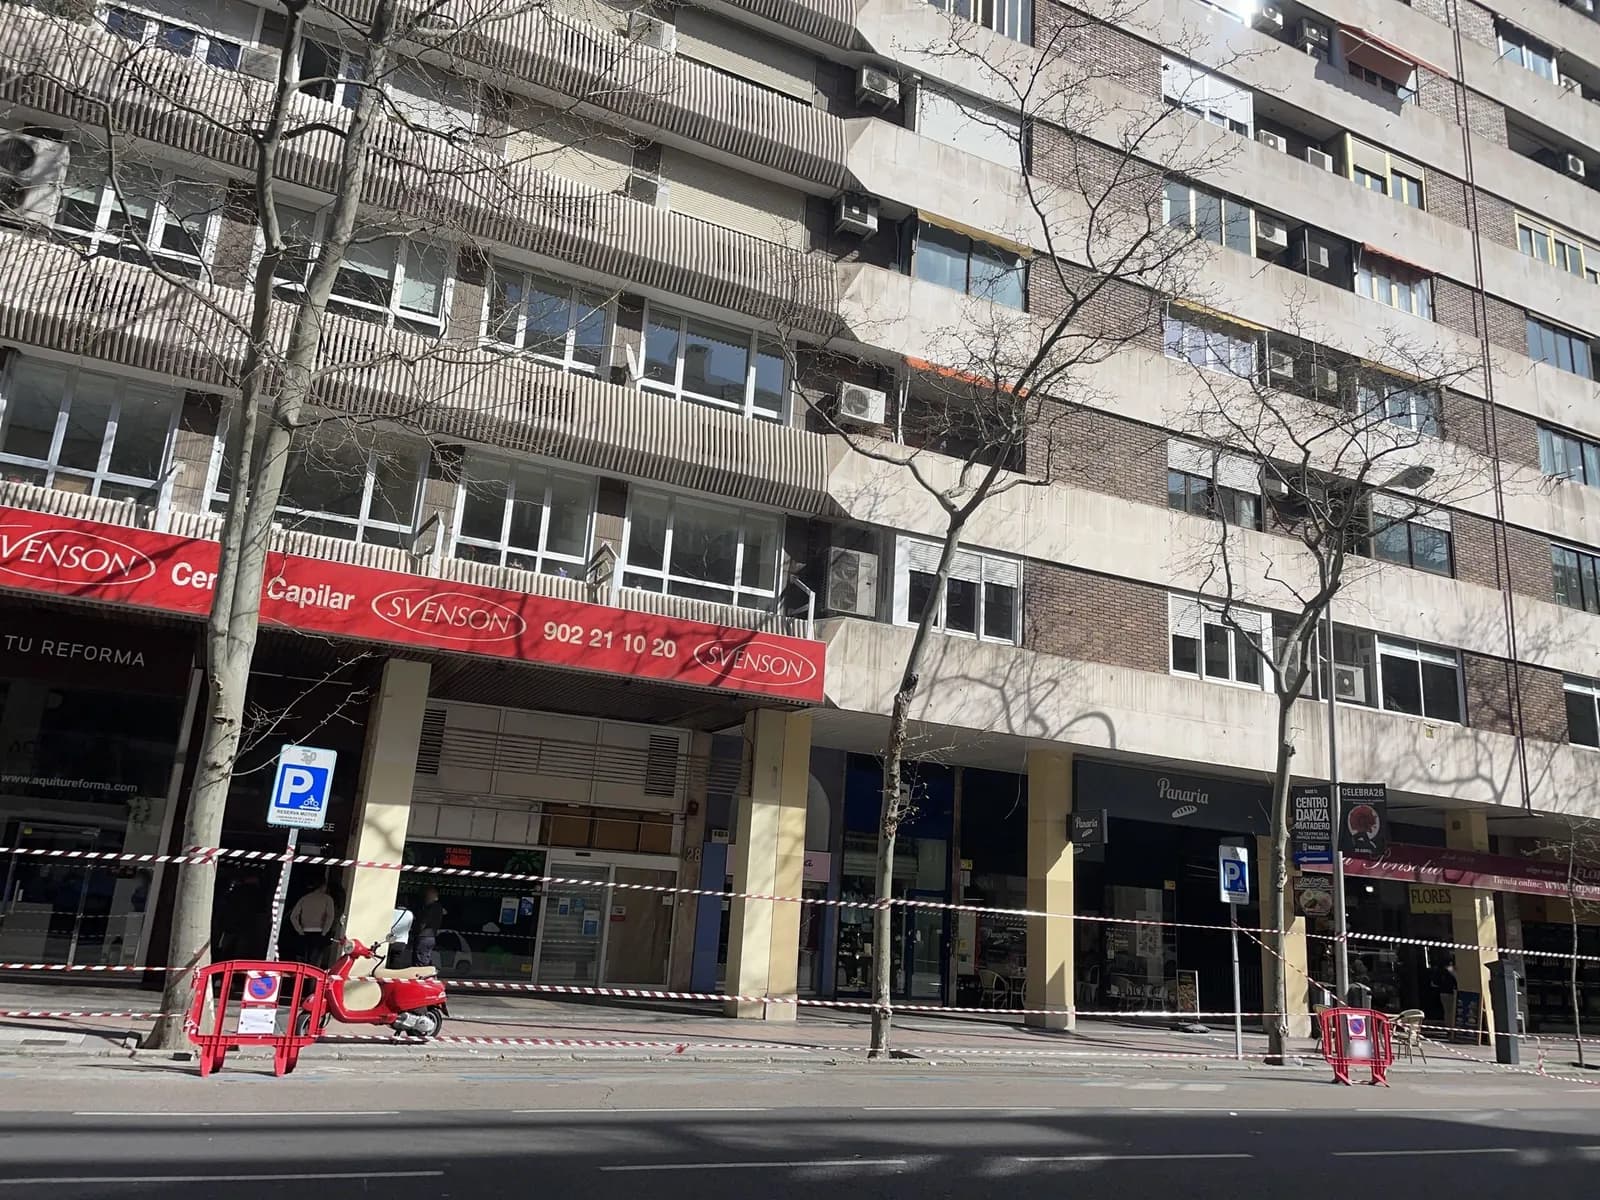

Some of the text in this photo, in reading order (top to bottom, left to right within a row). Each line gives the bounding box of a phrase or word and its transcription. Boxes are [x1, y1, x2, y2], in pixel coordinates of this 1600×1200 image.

[0, 534, 137, 577] VENSON
[266, 576, 355, 610] Capilar
[386, 596, 513, 633] SVENSON
[4, 635, 145, 667] TU REFORMA
[543, 621, 677, 658] 902 21 10 20
[706, 646, 804, 678] SVENSON
[1, 774, 138, 793] www.aquitureforma.com
[279, 767, 314, 805] P
[1156, 777, 1209, 804] Panaria
[1295, 797, 1328, 809] CENTRO
[1295, 809, 1330, 822] DANZA
[1074, 816, 1098, 829] Panaria
[1295, 822, 1330, 830] MATADERO
[687, 847, 701, 862] 28
[1224, 862, 1240, 889] P
[1493, 875, 1517, 886] Tienda
[1411, 888, 1452, 905] FLORES
